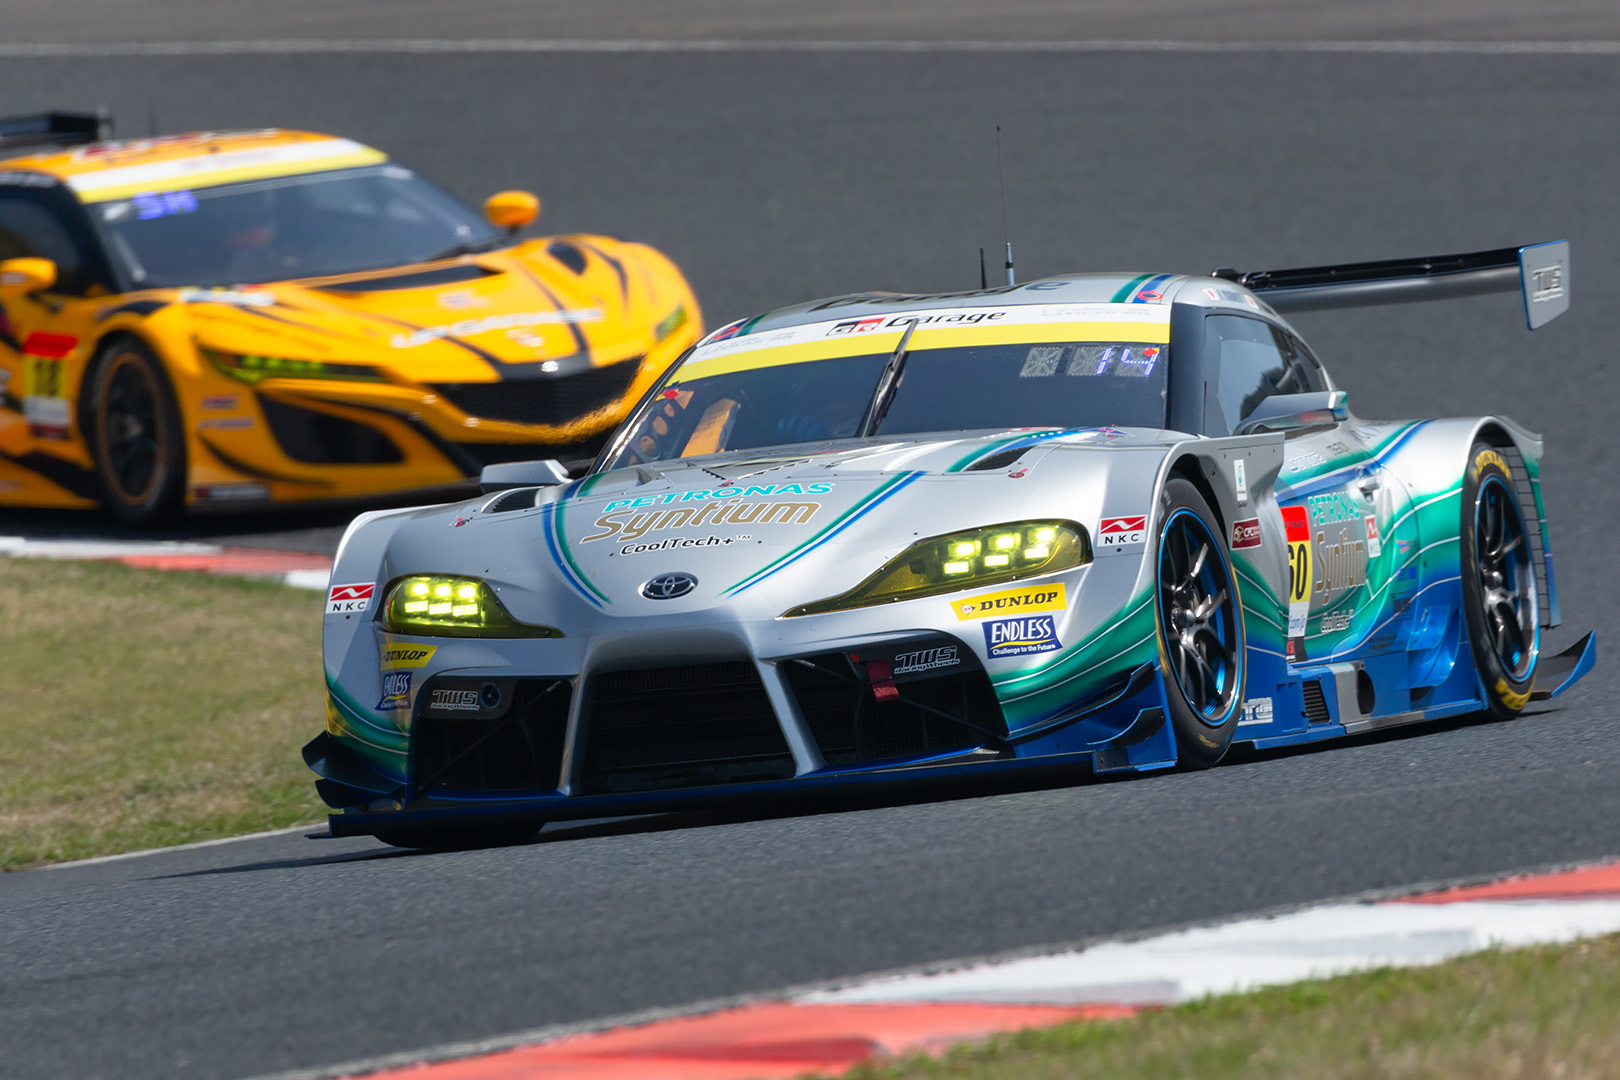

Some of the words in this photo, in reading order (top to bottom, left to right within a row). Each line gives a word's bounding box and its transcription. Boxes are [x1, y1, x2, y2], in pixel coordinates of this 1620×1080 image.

[885, 312, 1006, 327] Garage
[1096, 346, 1160, 376] 14
[603, 483, 836, 513] PETRONAS
[1308, 490, 1360, 527] PETRONAS
[580, 498, 821, 543] Syntium
[1104, 533, 1139, 545] NKC
[1314, 526, 1366, 606] Syntium
[332, 601, 366, 612] NKC
[979, 591, 1058, 611] DUNLOP
[990, 617, 1052, 643] ENDLESS
[385, 650, 429, 662] DUNLOP
[895, 645, 957, 668] TWS
[992, 647, 1020, 656] Challenge
[1037, 643, 1056, 651] Future
[384, 674, 410, 697] ENDLESS
[432, 689, 478, 705] TWS
